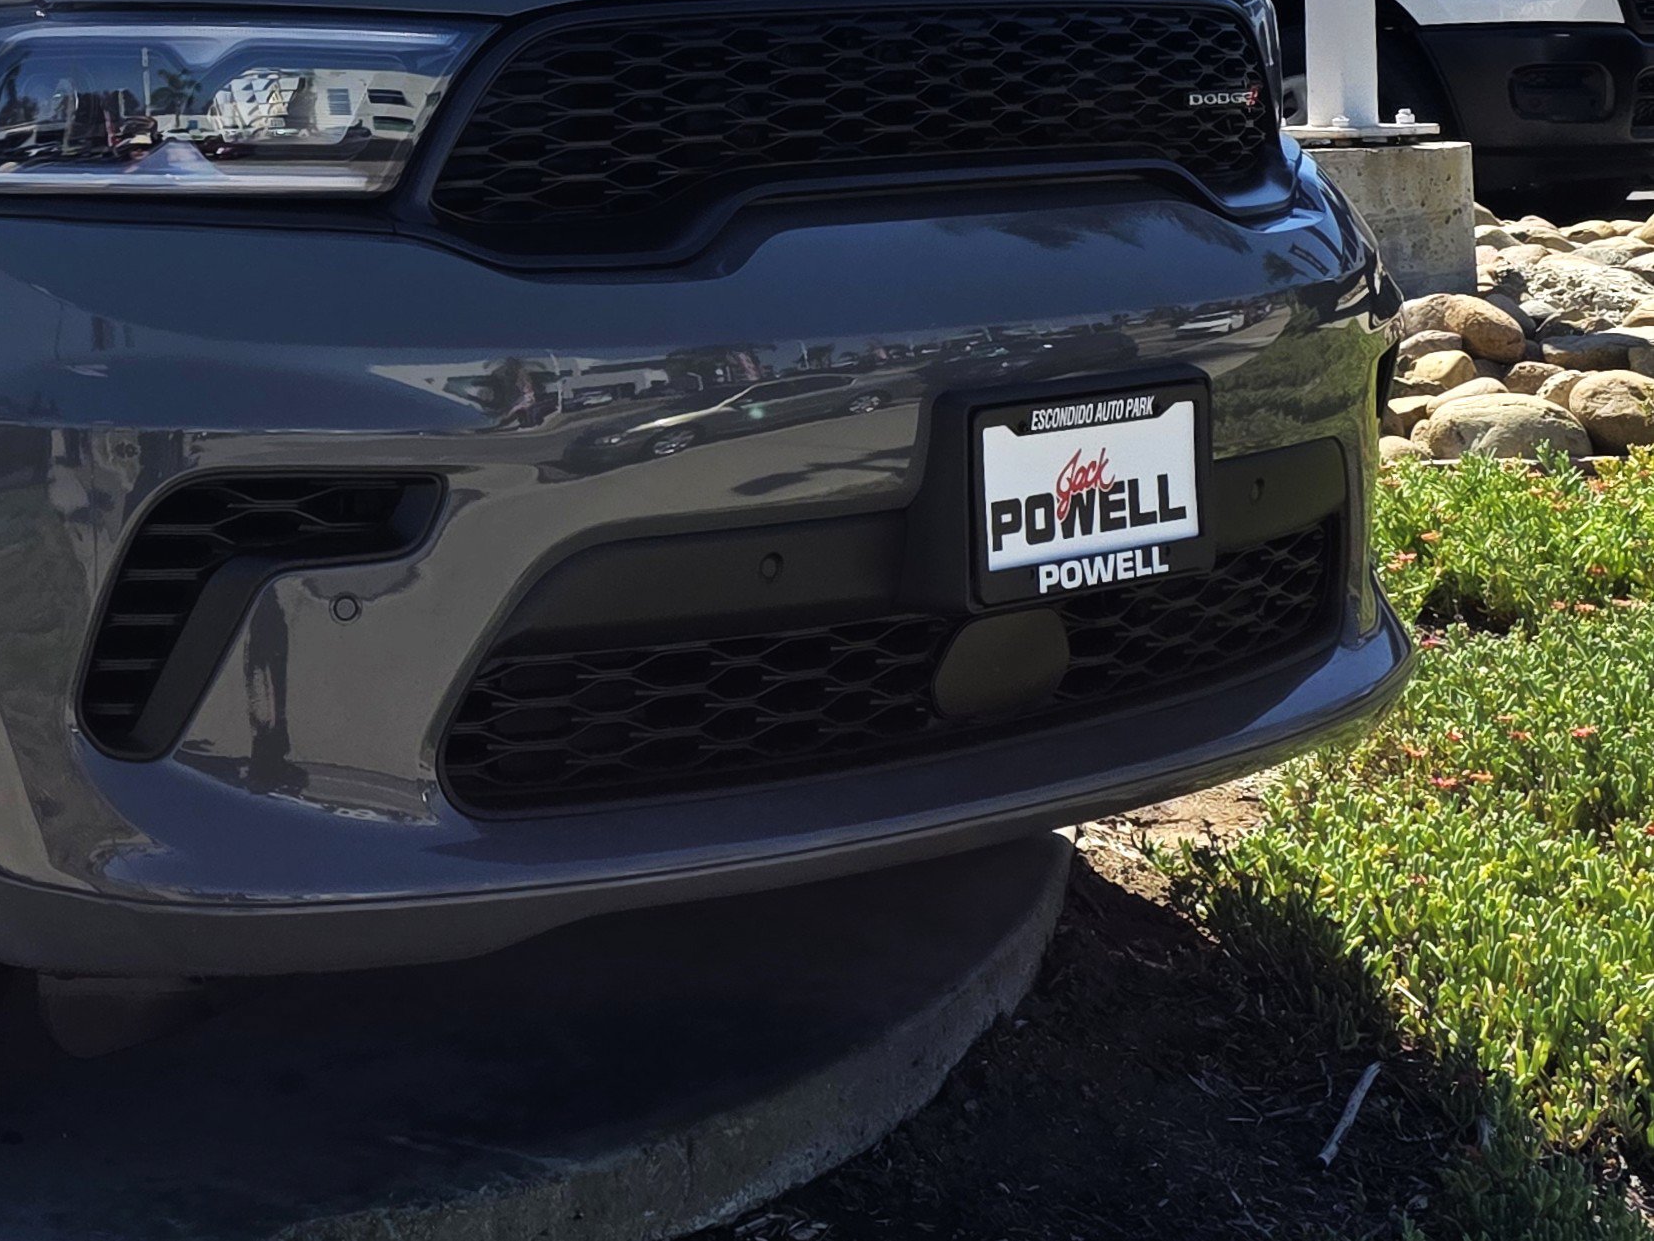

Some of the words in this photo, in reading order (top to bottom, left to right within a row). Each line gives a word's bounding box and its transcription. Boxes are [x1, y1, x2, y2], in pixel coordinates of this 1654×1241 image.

[1189, 91, 1254, 106] DODGE
[1031, 403, 1094, 431] ESCONDIDO
[1094, 399, 1124, 423] AUTO
[1125, 395, 1155, 418] PARK
[1056, 446, 1116, 521] Jack
[991, 473, 1187, 553] POWELL
[1039, 546, 1169, 594] POWELL
